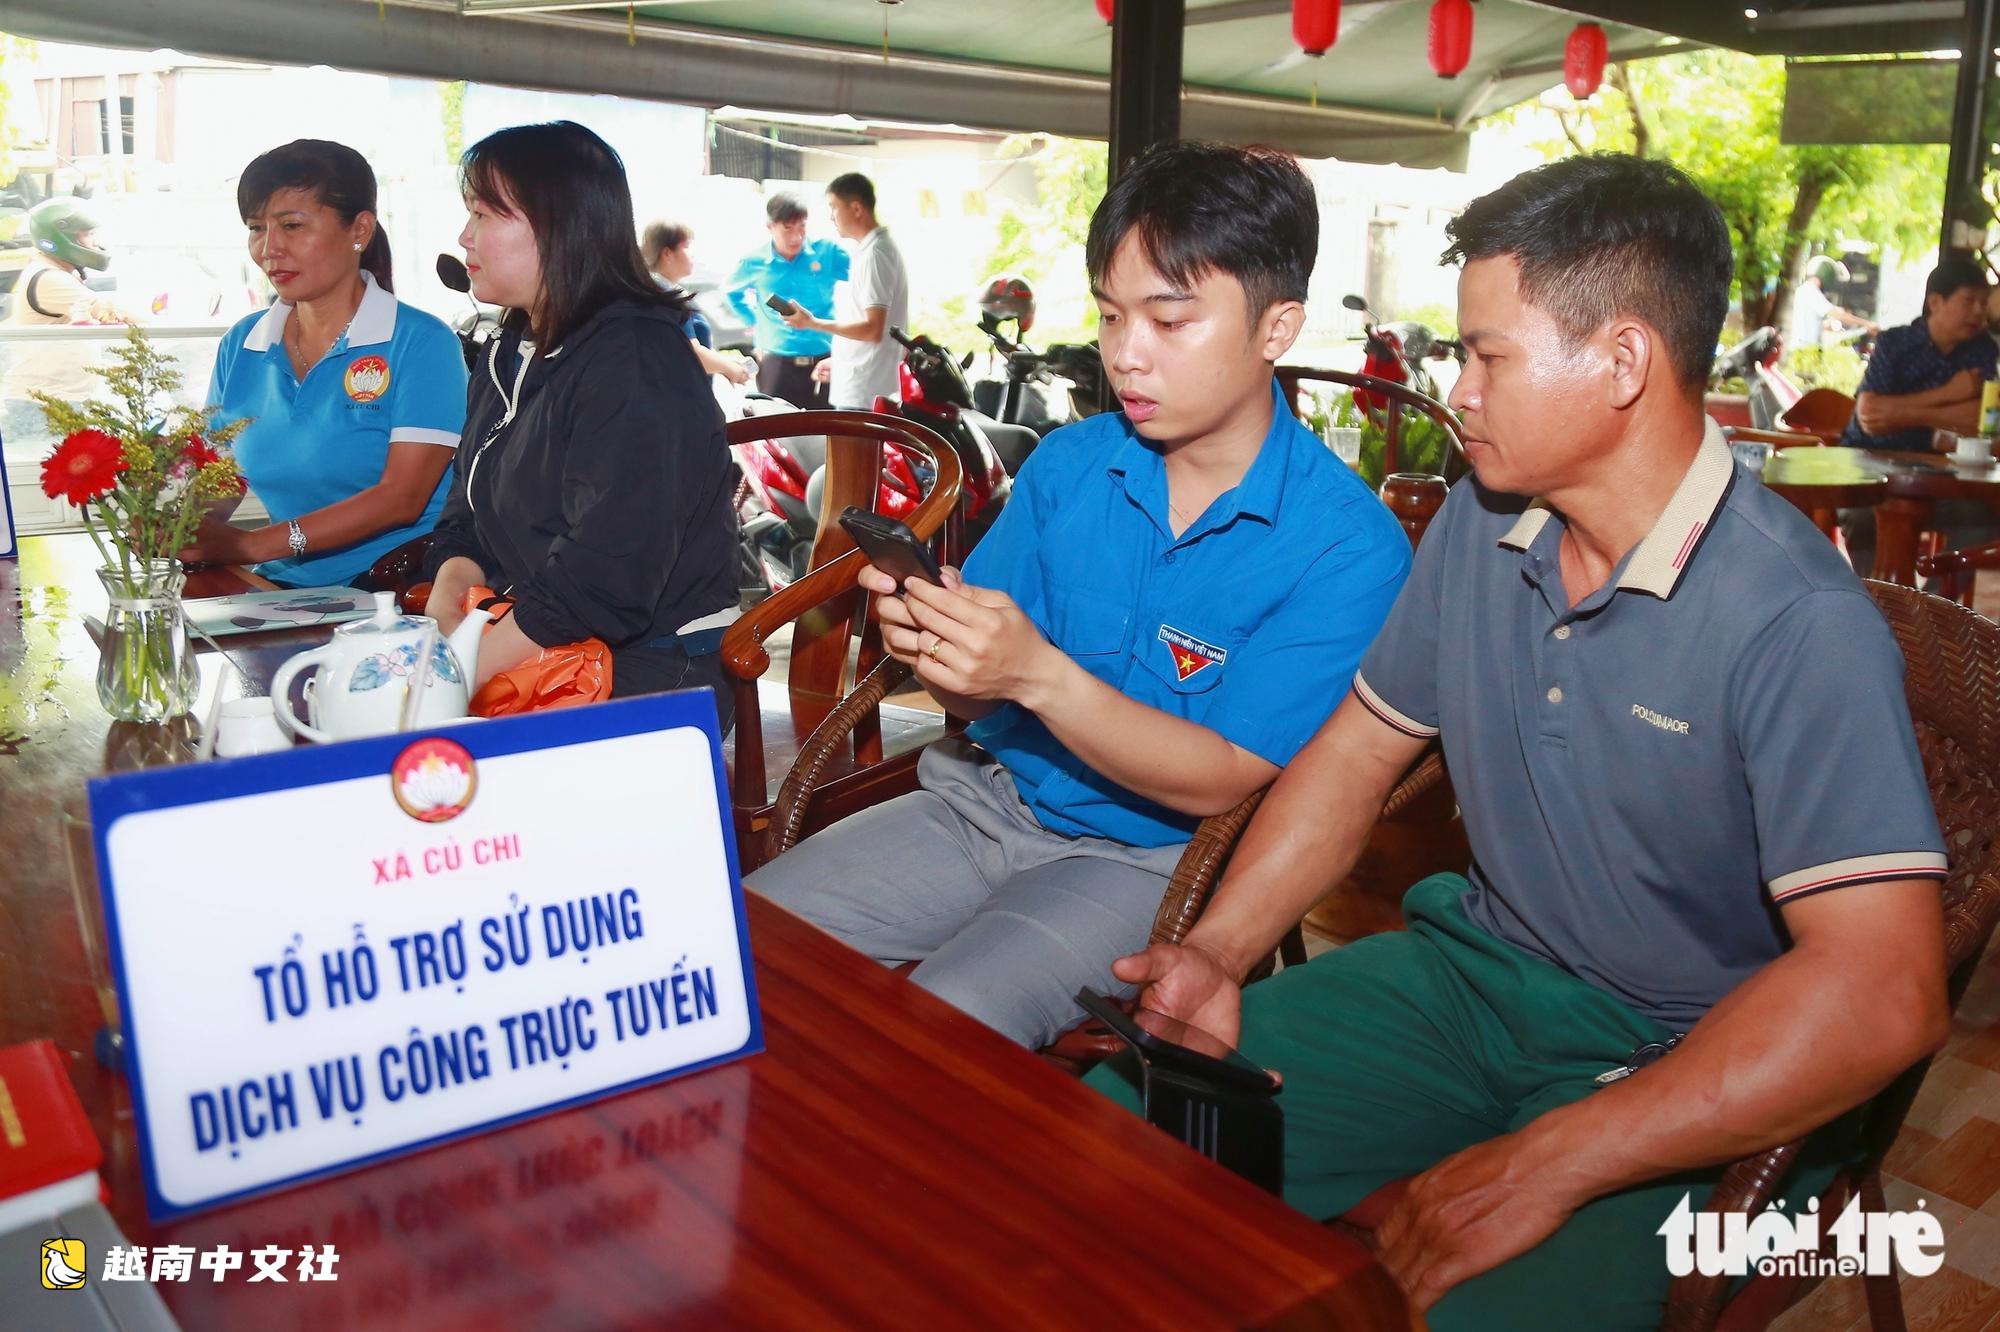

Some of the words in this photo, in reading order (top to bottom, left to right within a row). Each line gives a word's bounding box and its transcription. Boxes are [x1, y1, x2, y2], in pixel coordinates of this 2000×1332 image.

[1207, 649, 1224, 662] NAM
[423, 834, 462, 875] CỦ
[472, 833, 521, 866] CHI
[253, 934, 310, 1023] TỔ
[321, 923, 379, 1010] HỖ
[390, 918, 469, 994] TRỢ
[479, 892, 532, 973] SỬ
[541, 888, 644, 964] DỤNG
[188, 1070, 300, 1160] DỊCH
[307, 1054, 367, 1127] VỤ
[377, 1024, 492, 1104] CÔNG
[498, 996, 598, 1071] TRỰC
[605, 954, 719, 1042] TUYẾN
